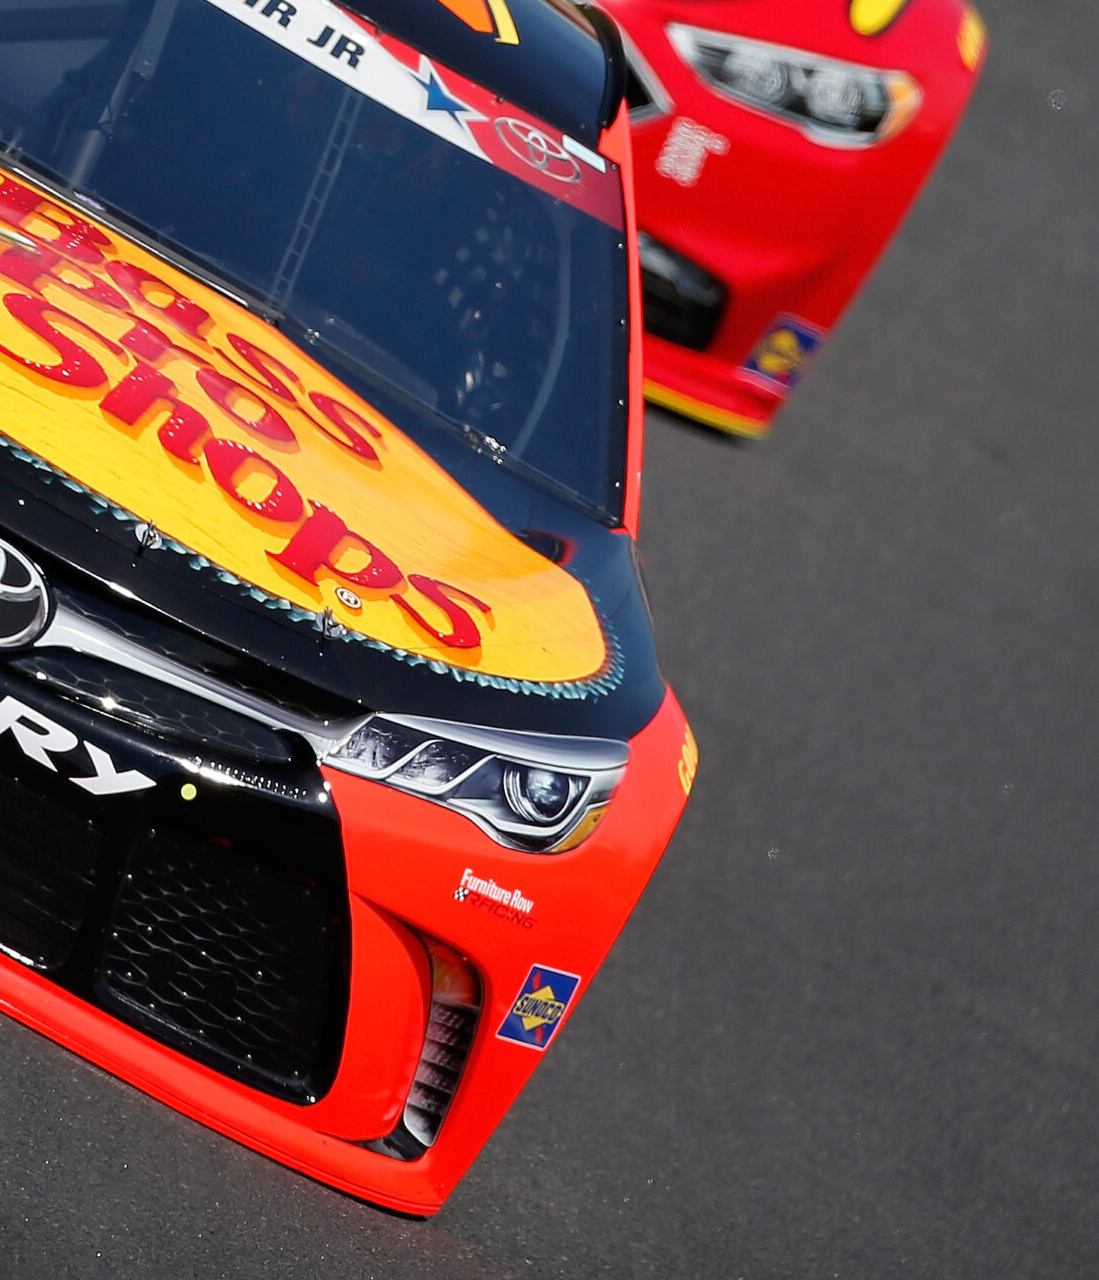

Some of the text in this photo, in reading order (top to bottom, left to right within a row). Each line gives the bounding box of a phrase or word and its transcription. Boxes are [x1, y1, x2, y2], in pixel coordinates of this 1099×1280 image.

[308, 26, 366, 69] JR
[460, 868, 534, 914] Furniture Row
[468, 890, 538, 929] RACING
[514, 995, 563, 1022] SUNOCO
